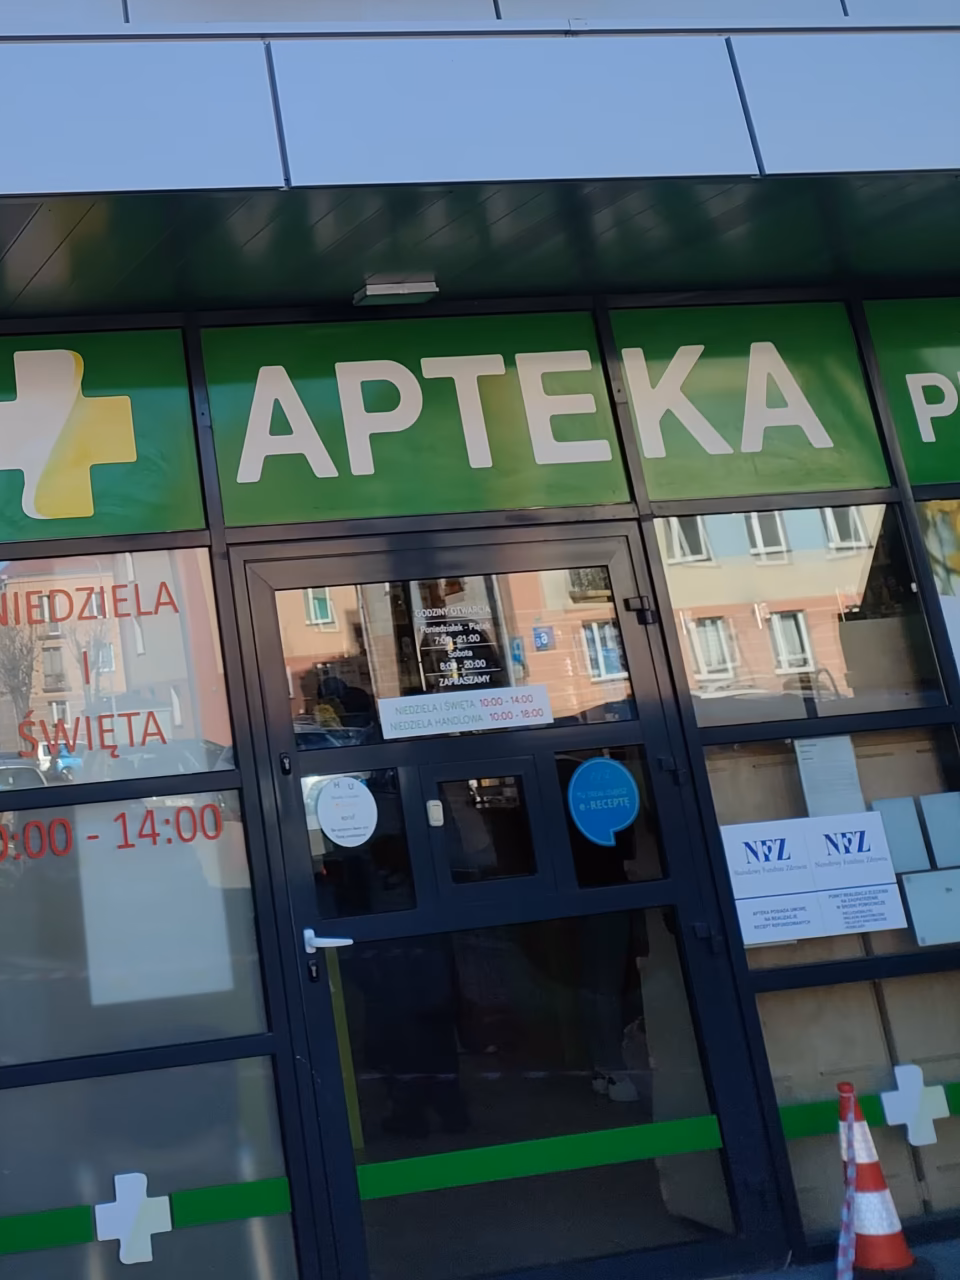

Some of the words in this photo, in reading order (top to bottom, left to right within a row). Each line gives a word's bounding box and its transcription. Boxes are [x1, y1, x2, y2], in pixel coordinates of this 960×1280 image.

[236, 341, 835, 484] APTEKA
[905, 372, 960, 442] P
[415, 608, 449, 618] GODZINY
[450, 606, 491, 615] OTWARCIA
[420, 623, 463, 634] Poniedziałek
[469, 622, 491, 632] Piątek
[458, 634, 481, 643] 21:00
[448, 650, 473, 658] Sobota
[464, 660, 487, 669] 20:00
[439, 675, 490, 687] ZAPRASZAMY
[395, 704, 438, 716] NIEDZIELA
[444, 700, 476, 712] ŚWIĘTA
[479, 697, 503, 708] 10:00
[511, 694, 533, 704] 14:00
[390, 720, 433, 731] NIEDZIELA
[435, 714, 484, 726] HANDLOWA
[490, 710, 513, 721] 10:00
[521, 708, 544, 718] 18:00
[18, 709, 168, 759] ŚWIĘTA
[113, 802, 224, 850] 14:00
[741, 837, 791, 865] NFZ
[822, 830, 871, 857] NFZ
